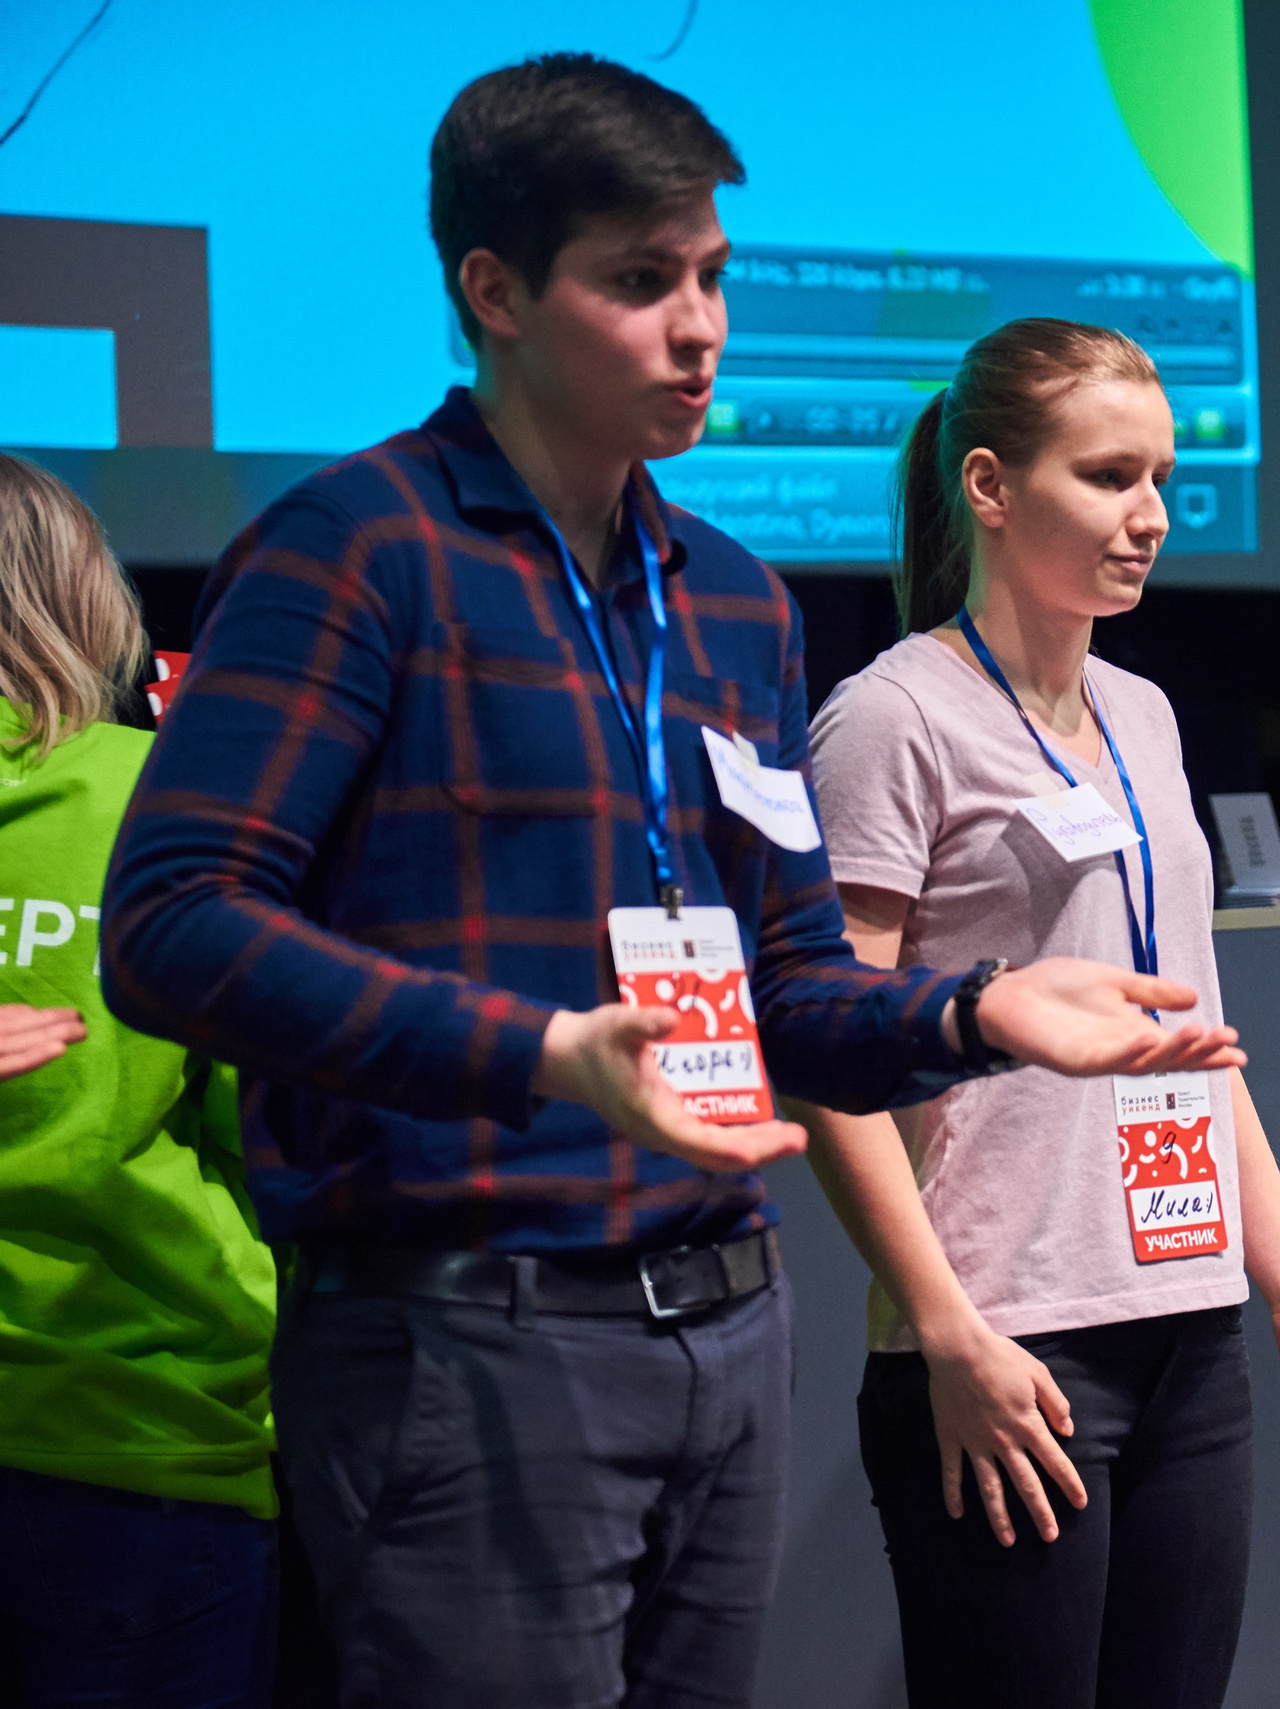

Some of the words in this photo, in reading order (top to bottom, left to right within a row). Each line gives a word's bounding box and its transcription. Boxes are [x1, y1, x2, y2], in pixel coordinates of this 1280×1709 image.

[683, 1094, 760, 1117] АСТНИК
[1121, 1095, 1159, 1105] бизнес
[1122, 1103, 1161, 1116] уикенд
[1161, 1131, 1177, 1165] 9
[1144, 1228, 1219, 1253] УЧАСТНИК
